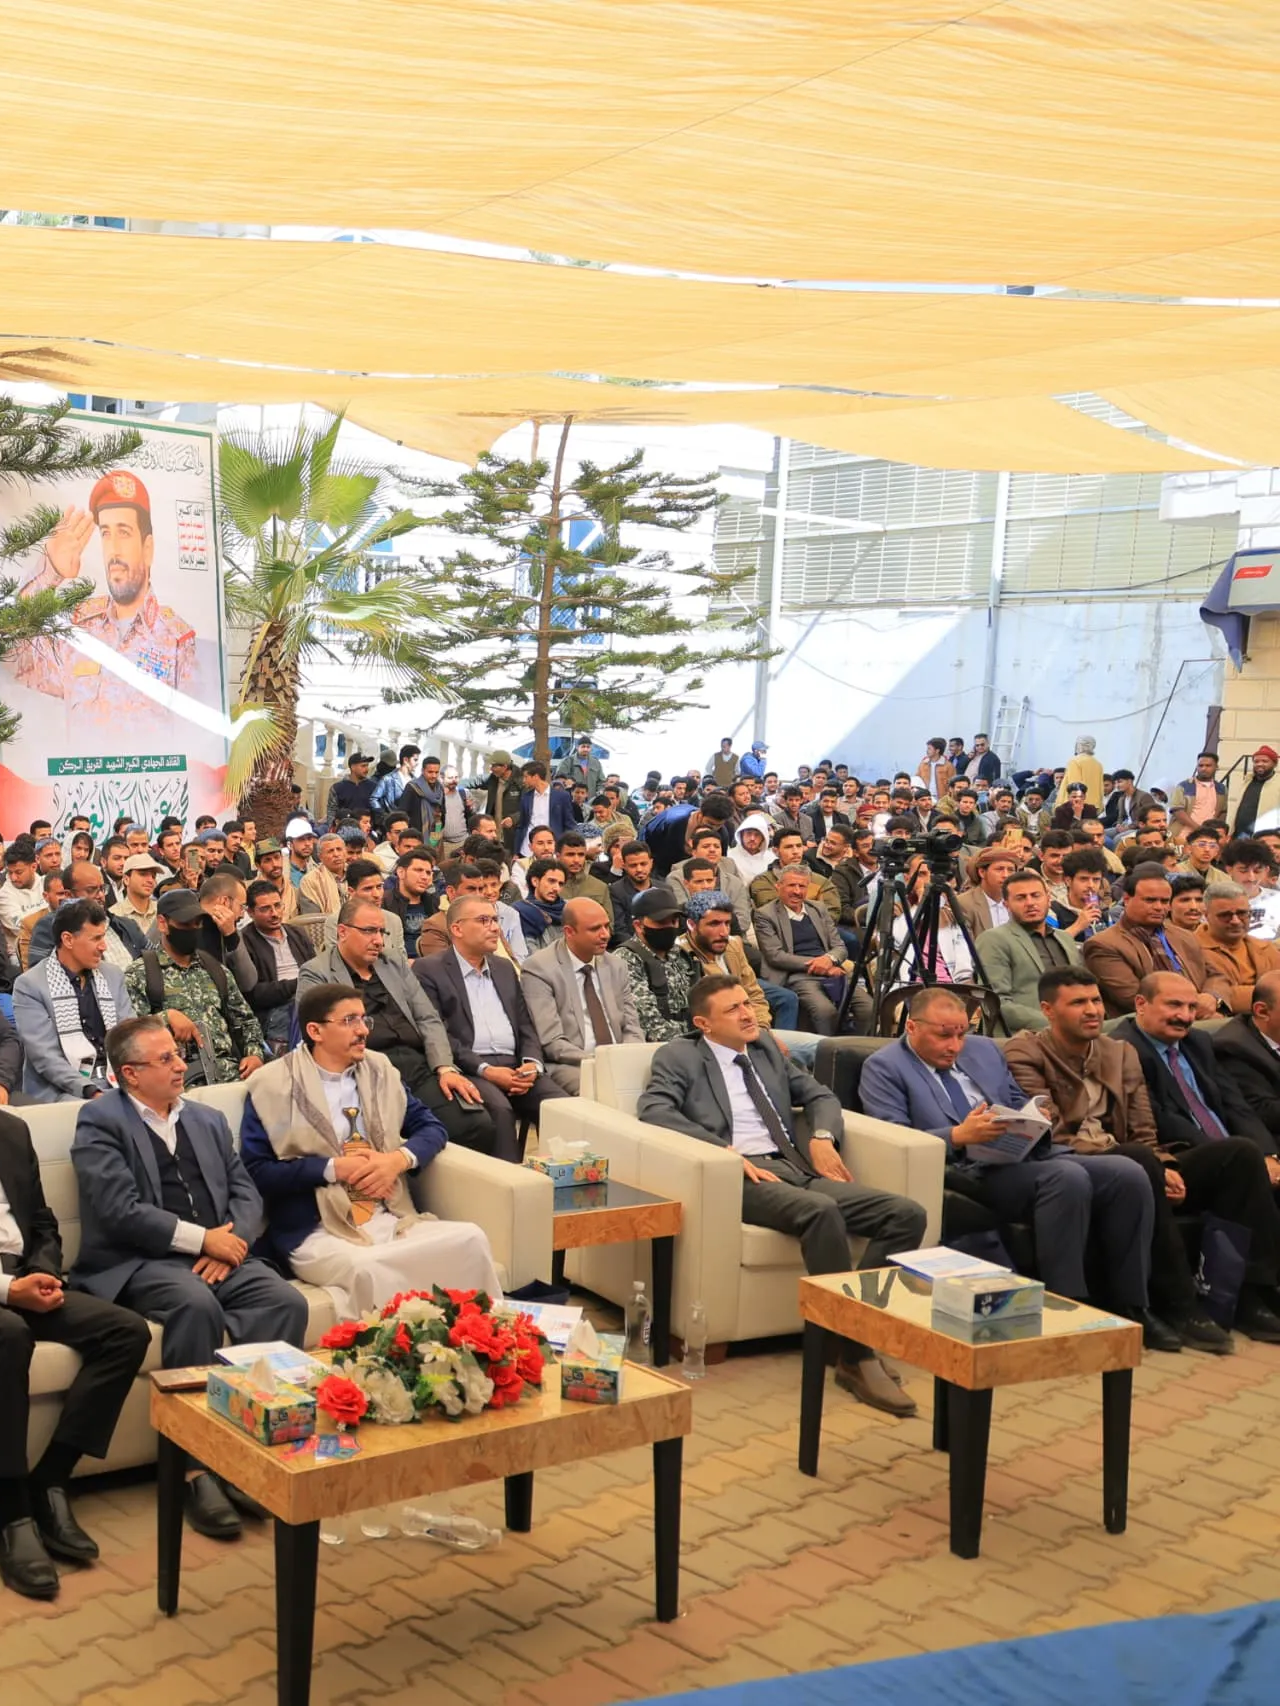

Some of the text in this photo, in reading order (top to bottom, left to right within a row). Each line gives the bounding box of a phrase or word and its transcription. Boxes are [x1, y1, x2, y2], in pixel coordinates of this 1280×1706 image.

[58, 760, 83, 773] الركن
[106, 757, 124, 771] الشهيد
[142, 757, 165, 771] الجهادي
[165, 756, 181, 768] القائد
